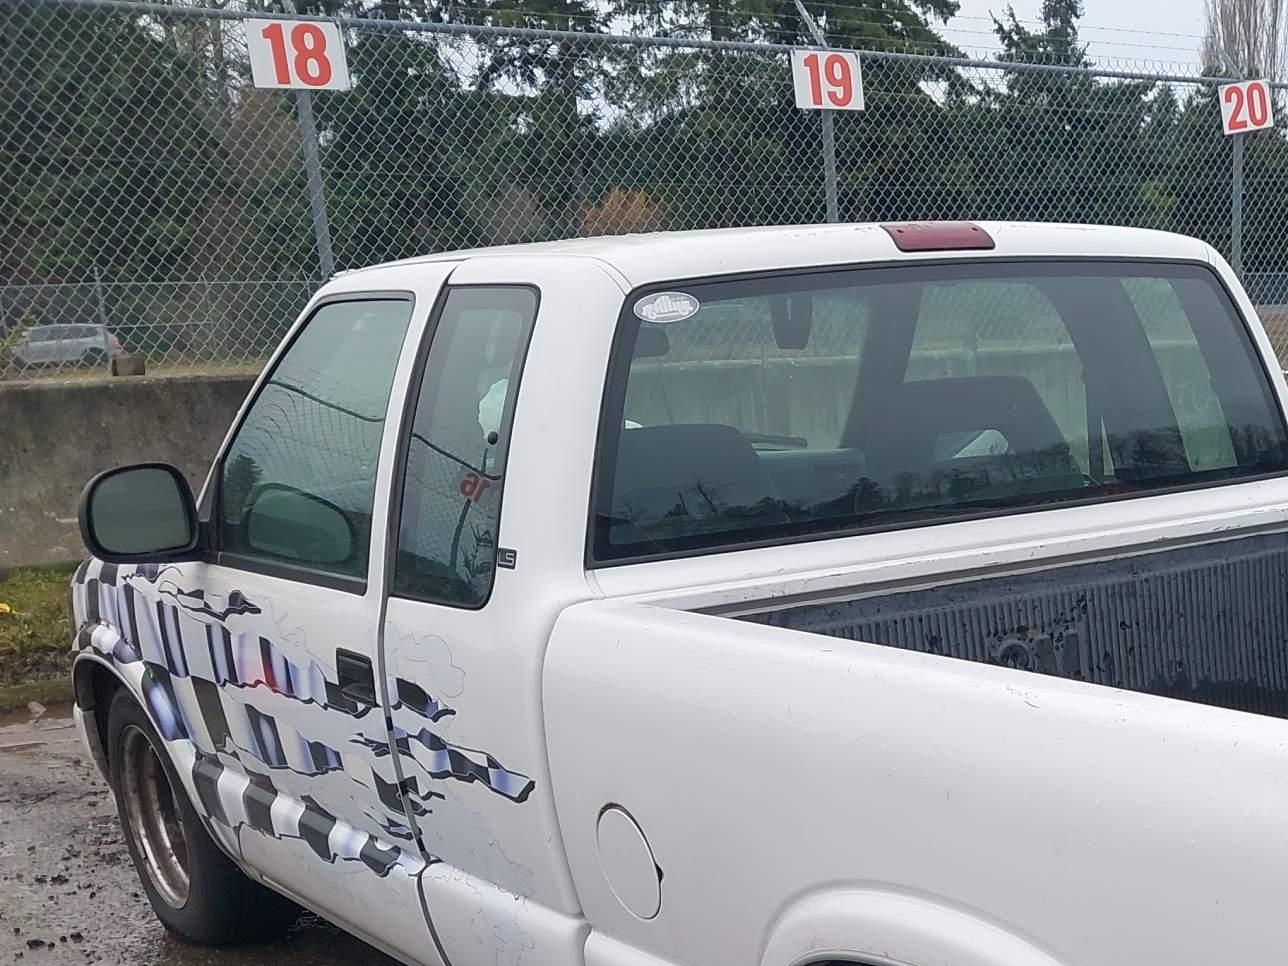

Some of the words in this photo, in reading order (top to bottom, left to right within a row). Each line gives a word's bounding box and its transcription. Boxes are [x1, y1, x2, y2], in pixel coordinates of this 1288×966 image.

[262, 22, 332, 87] 18
[804, 53, 853, 108] 19
[1224, 82, 1269, 131] 20
[498, 551, 515, 567] LS
